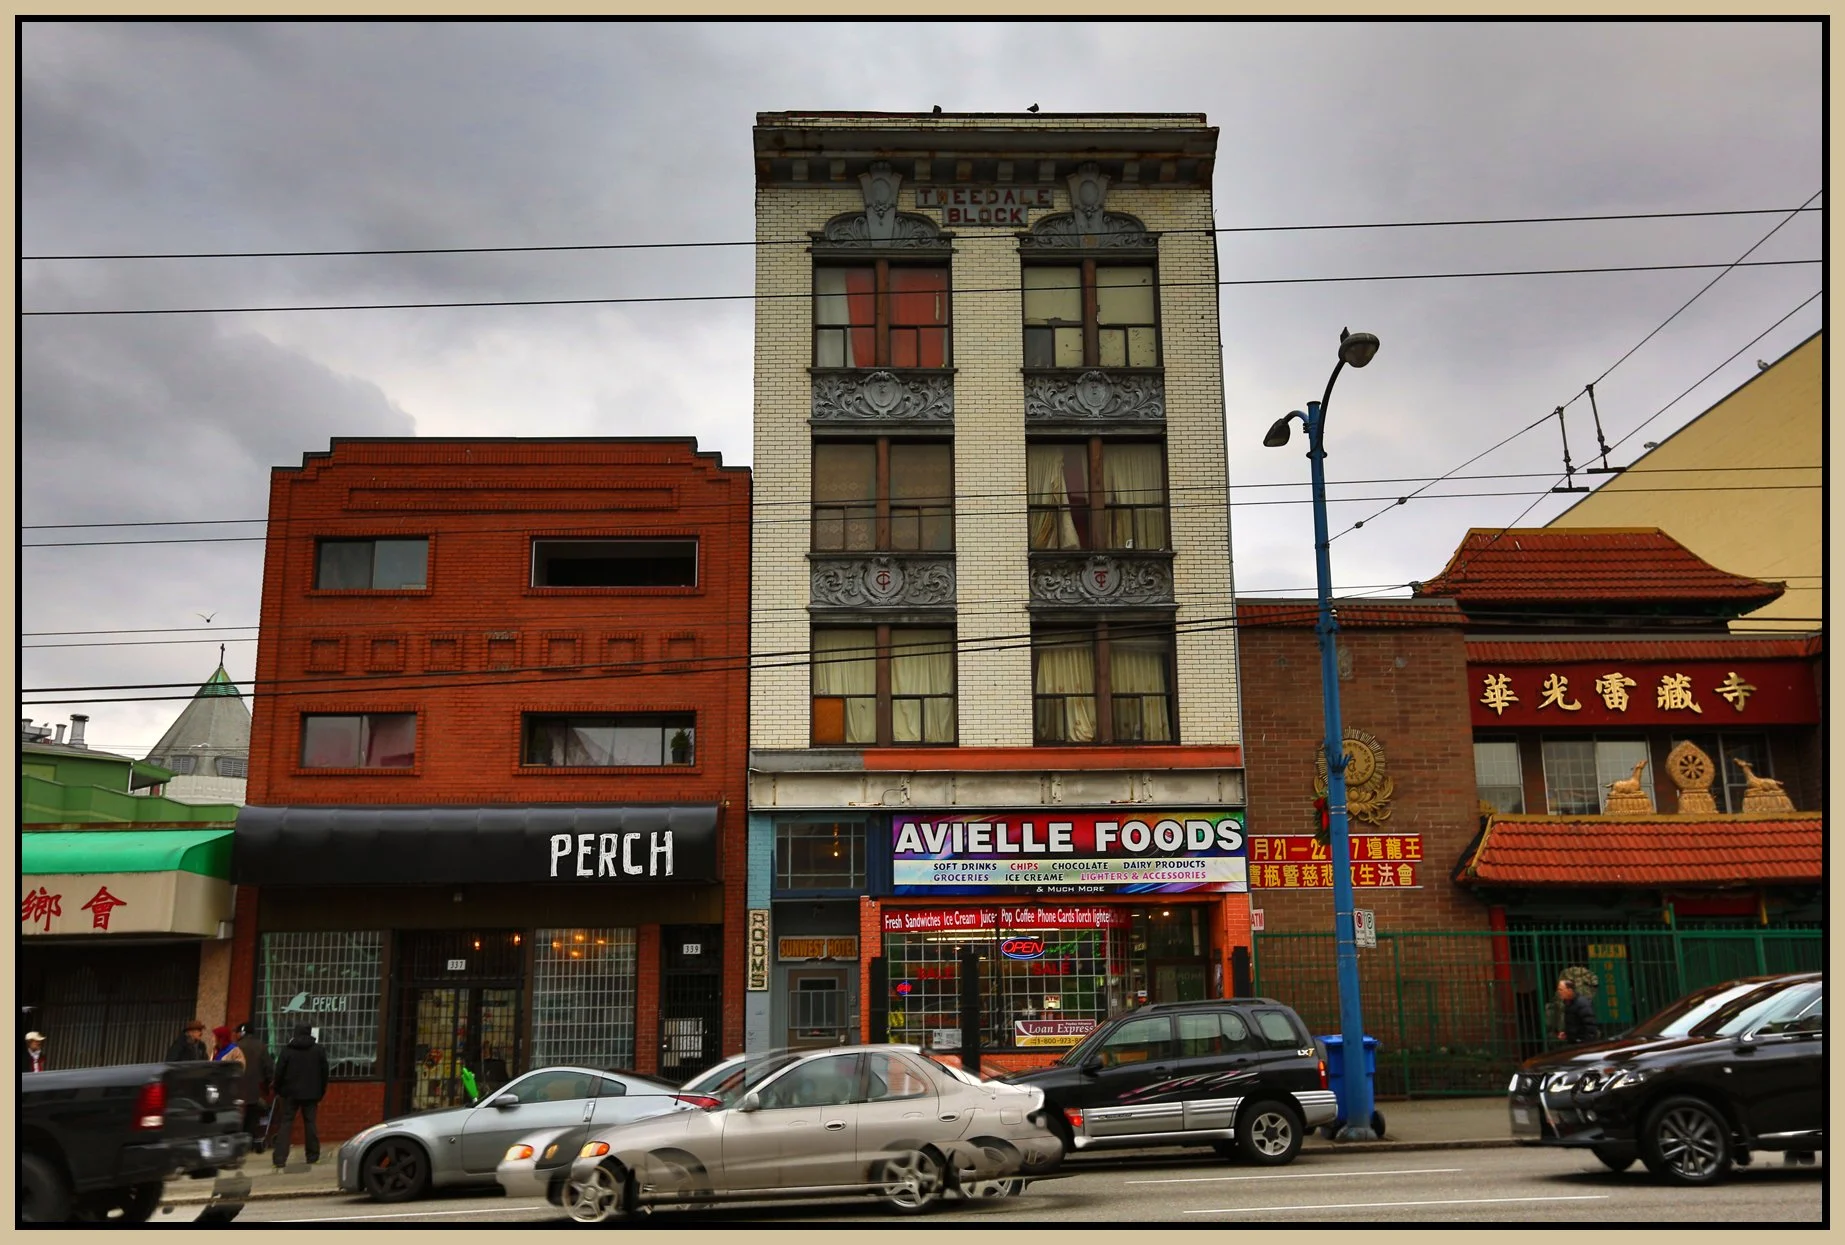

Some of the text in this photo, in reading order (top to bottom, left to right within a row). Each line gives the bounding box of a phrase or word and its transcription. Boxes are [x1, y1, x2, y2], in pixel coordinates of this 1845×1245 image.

[919, 188, 1049, 205] TWEEDALE
[947, 207, 1023, 223] BLOCK
[1479, 671, 1757, 715] 華光雷藏寺
[894, 820, 1243, 853] AVIELLE FOODS
[550, 830, 674, 877] PERCH
[933, 860, 1206, 871] SOFT DRINKS CHIPS CHOCOLATE DAIRY PRODUCTS
[933, 871, 1206, 882] GROCERIES ICE CREAME LIGHTERS & ACCESSORIES
[1078, 885, 1105, 893] MORE
[885, 914, 902, 929] Fresh
[905, 912, 941, 928] Sandwiches
[943, 911, 953, 926] Ice
[954, 910, 976, 925] Cream
[1001, 908, 1013, 926] Pop
[1015, 908, 1035, 923] Coffee
[1037, 908, 1056, 923] Phone
[1057, 908, 1075, 923] Cards
[1075, 908, 1092, 923] Torch
[1251, 913, 1264, 927] ATM
[685, 944, 699, 953] 339
[751, 912, 765, 988] ROOMS
[780, 937, 857, 957] SUNWEST HOTEL
[1003, 941, 1044, 953] OPEN
[449, 960, 464, 969] 337
[1032, 962, 1070, 976] SALE
[312, 996, 347, 1012] PERCH
[1028, 1023, 1094, 1036] Loan Express
